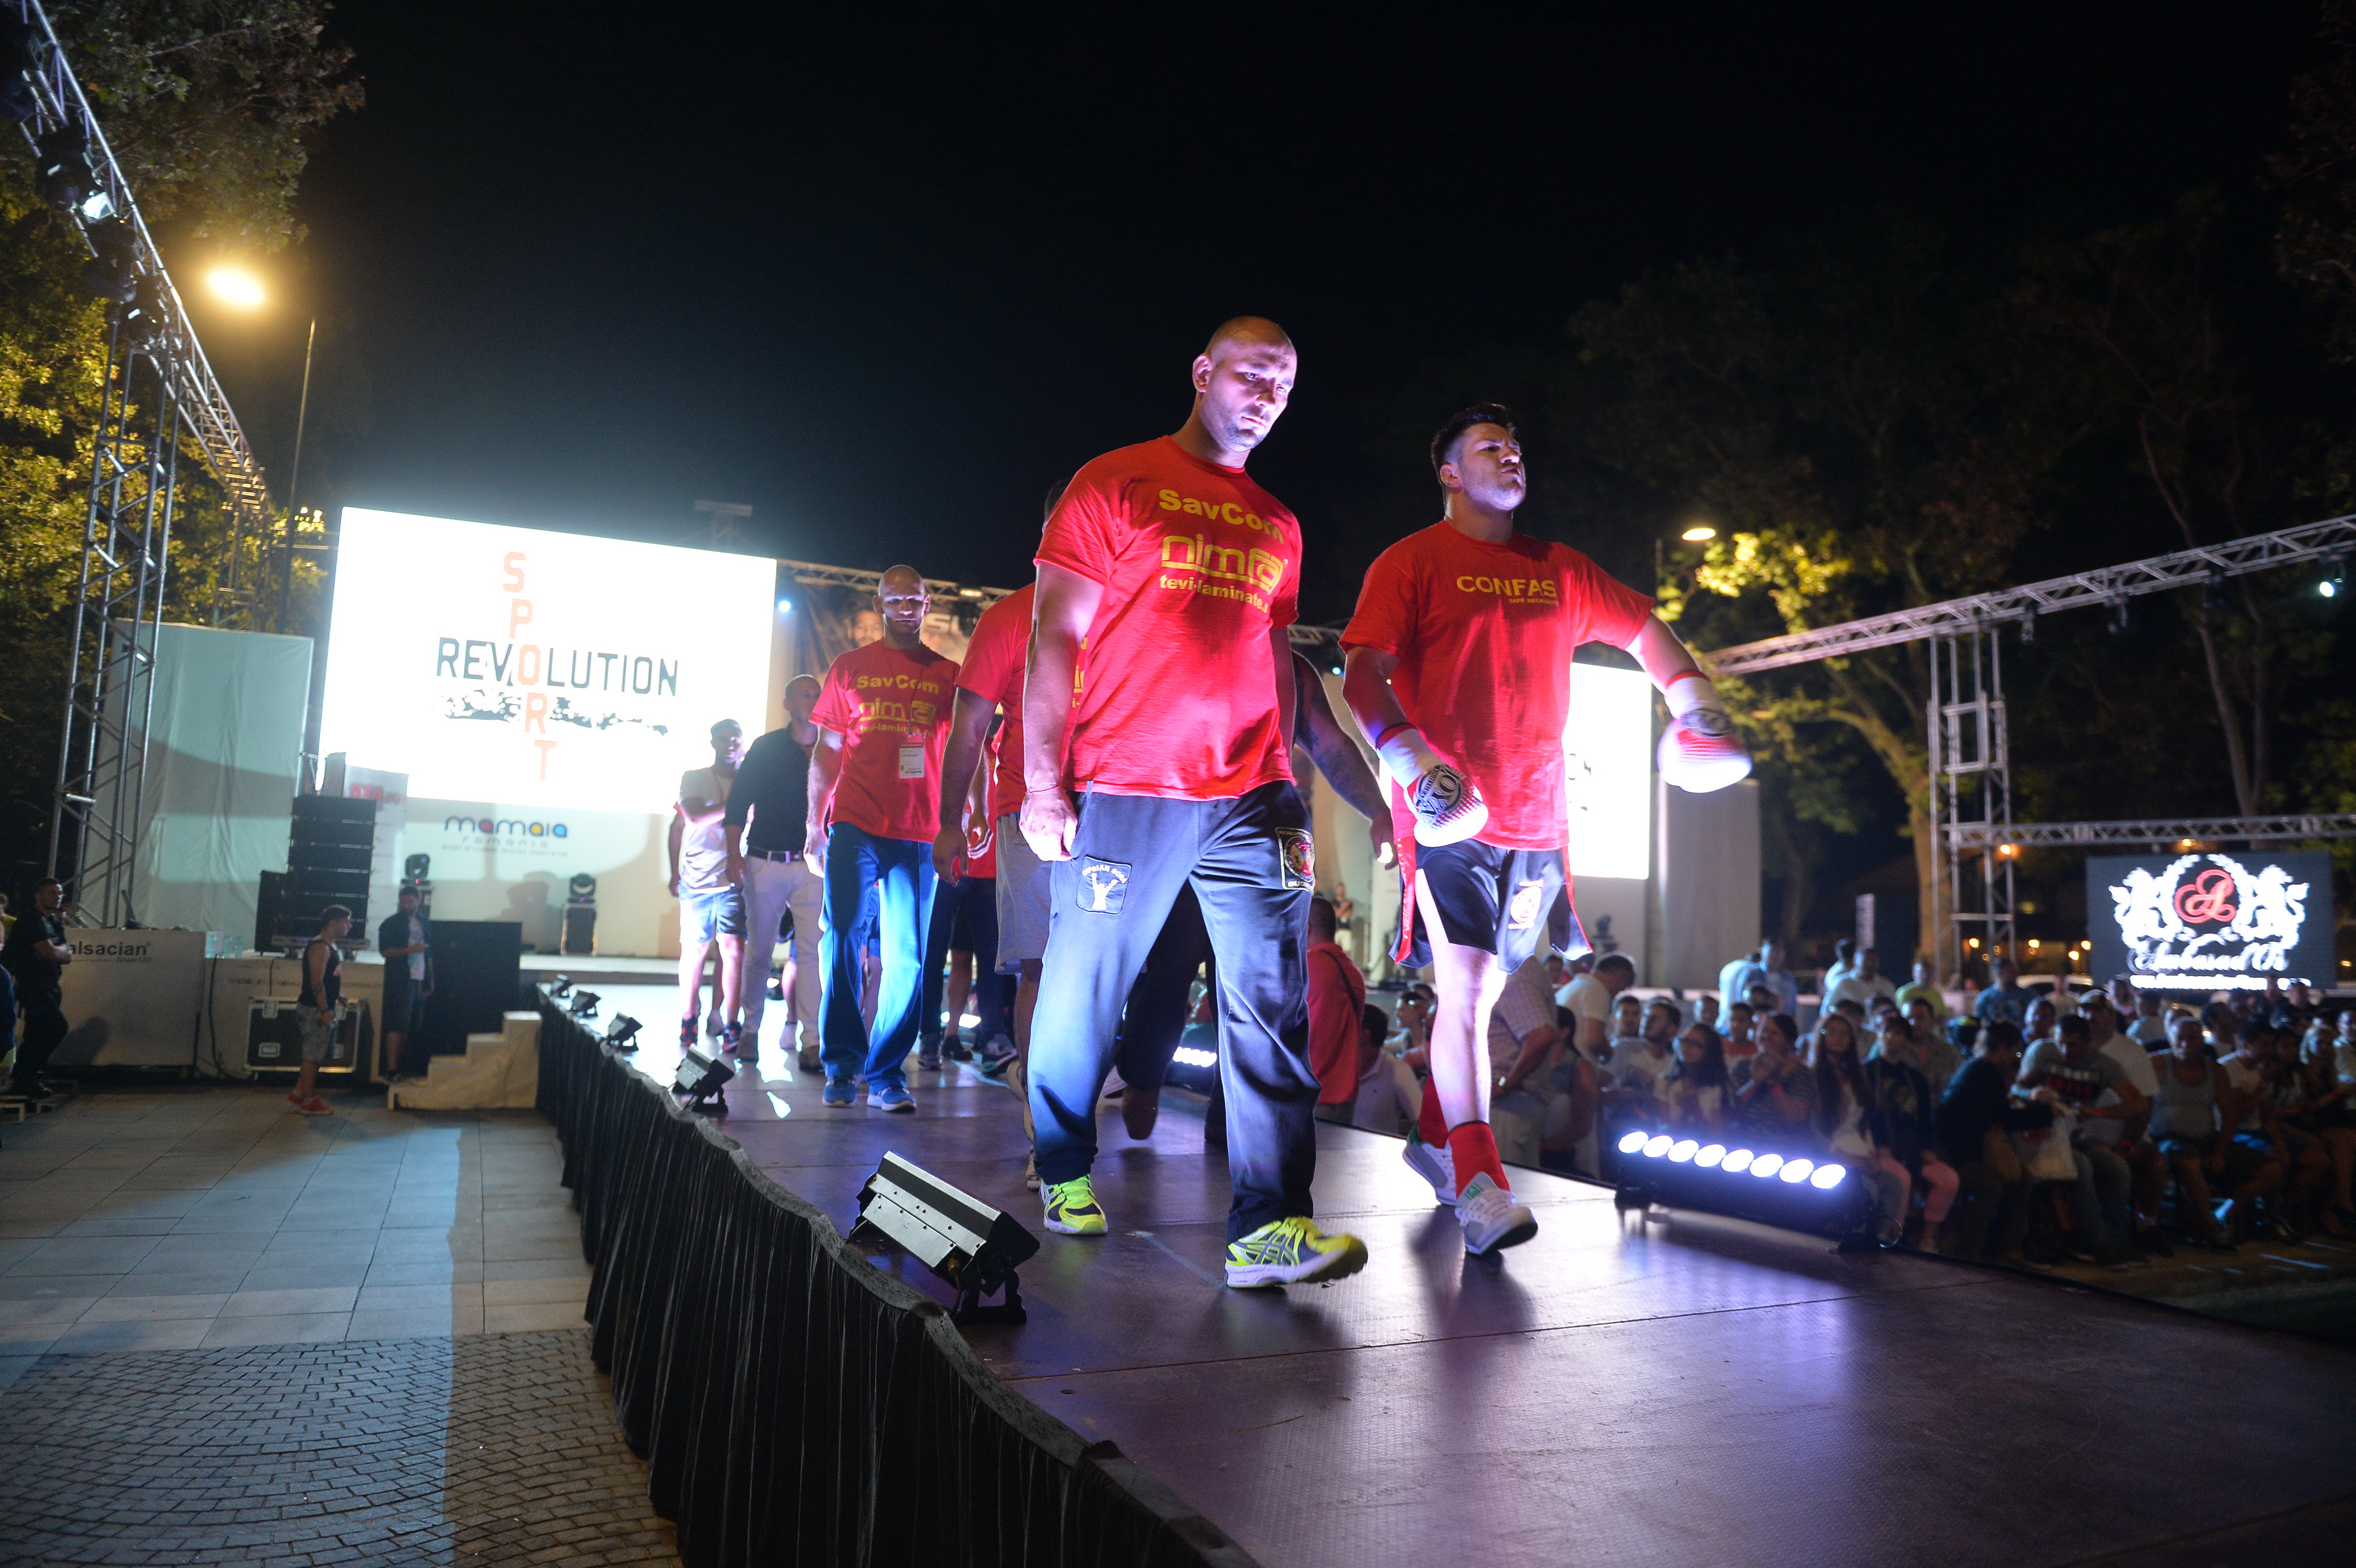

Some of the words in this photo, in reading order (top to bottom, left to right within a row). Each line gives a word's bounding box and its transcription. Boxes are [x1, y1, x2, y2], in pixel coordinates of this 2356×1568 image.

[1159, 489, 1284, 544] SavCom
[1457, 576, 1557, 597] CONFAS
[436, 637, 678, 697] REVOLUTION
[502, 552, 557, 781] SPORT
[857, 675, 939, 694] SavCom
[444, 817, 567, 838] mamaia
